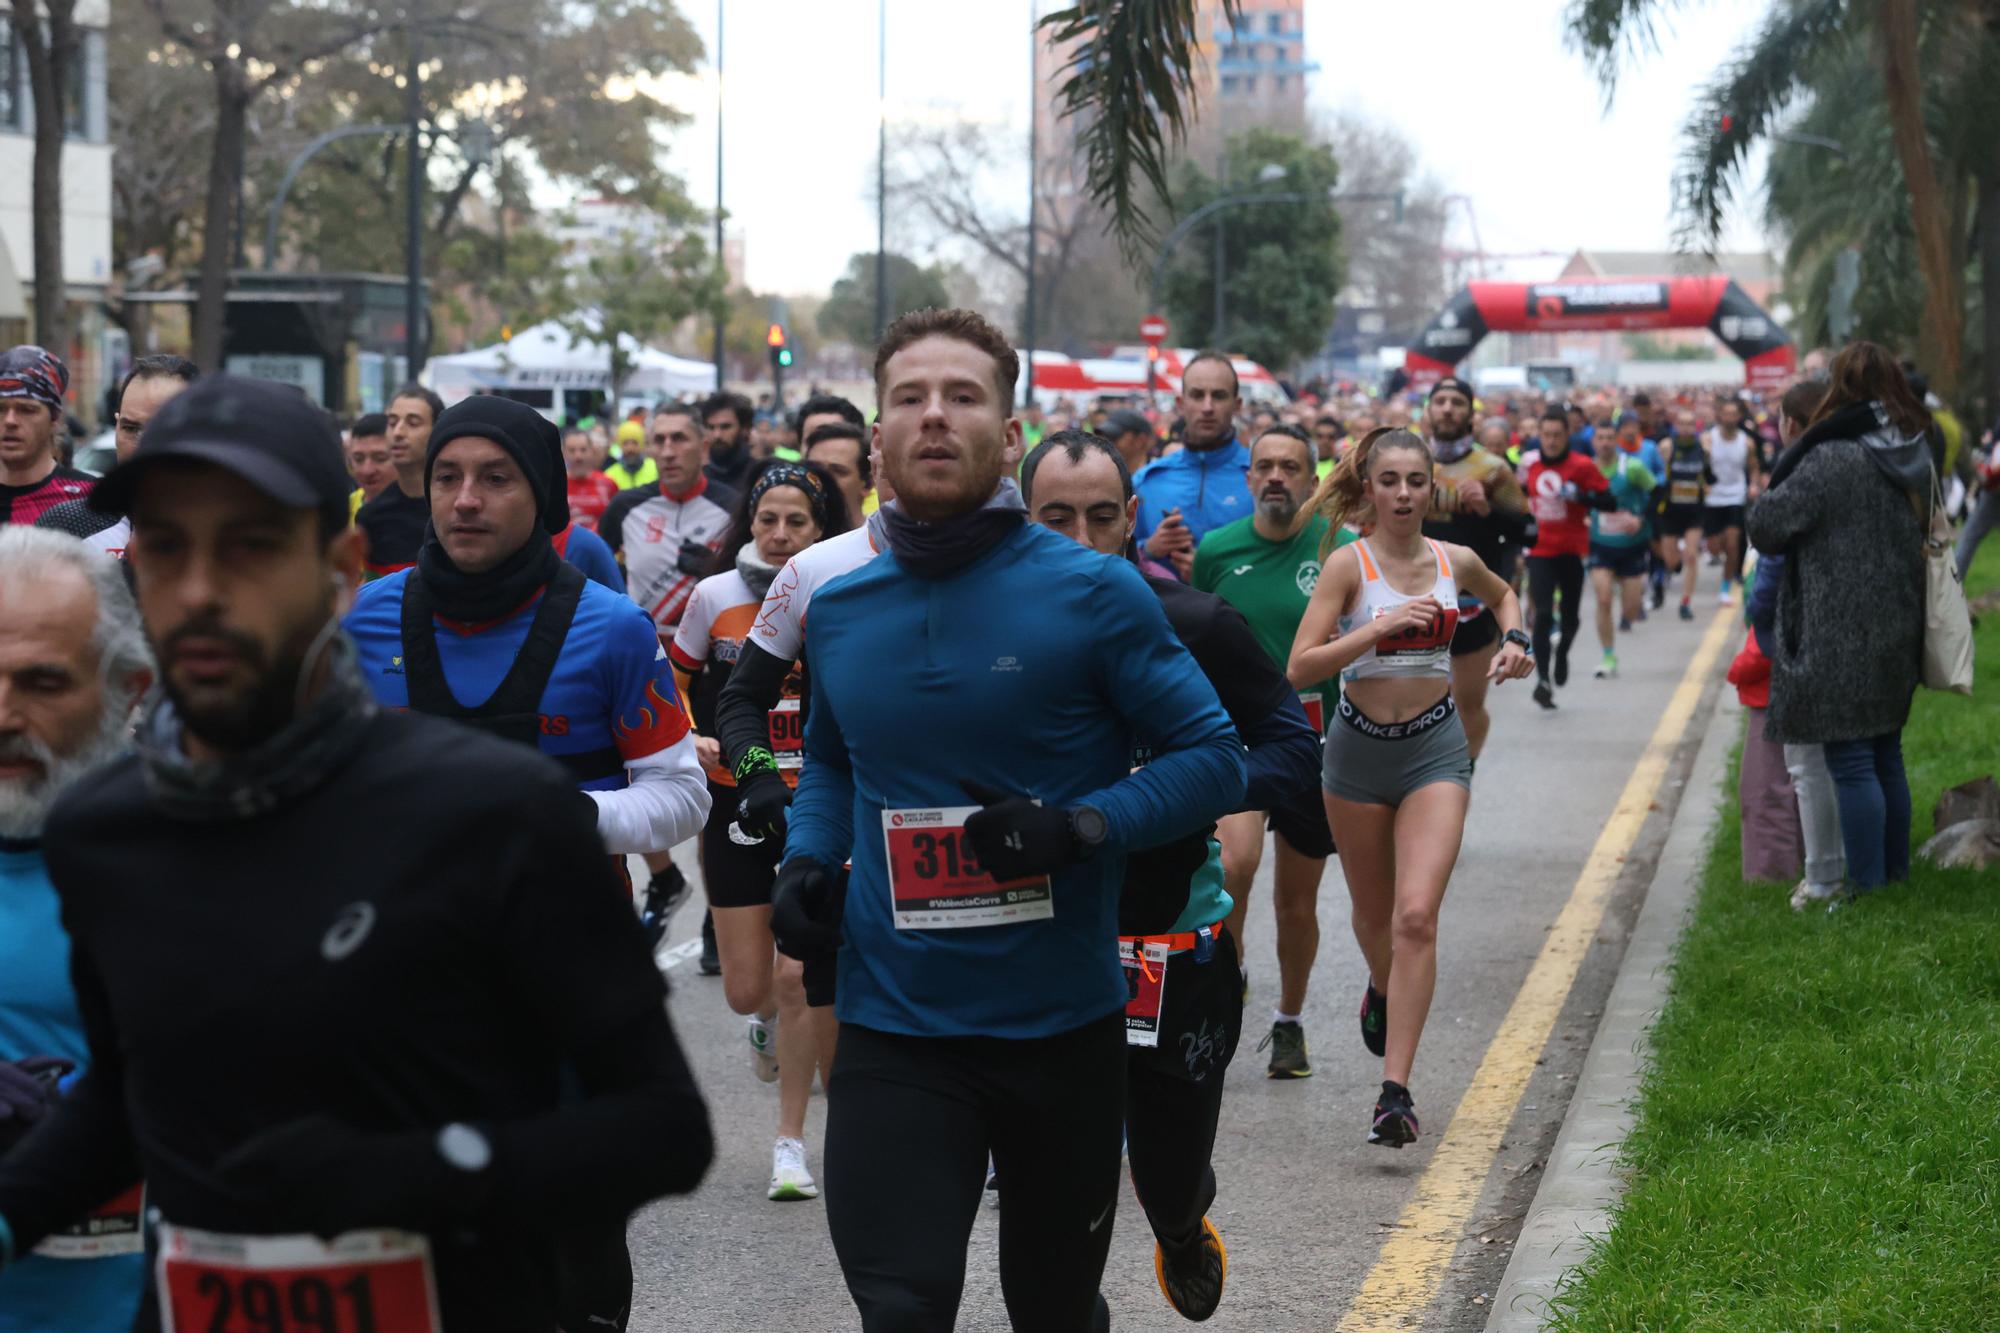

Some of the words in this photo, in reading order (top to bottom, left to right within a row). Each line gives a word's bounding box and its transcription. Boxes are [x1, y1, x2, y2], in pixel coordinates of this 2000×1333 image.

[1354, 716, 1403, 737] NIKE
[1406, 705, 1446, 734] PRO
[913, 832, 985, 880] 319
[929, 896, 1000, 908] #ValènciaCorre
[196, 1272, 378, 1333] 2991
